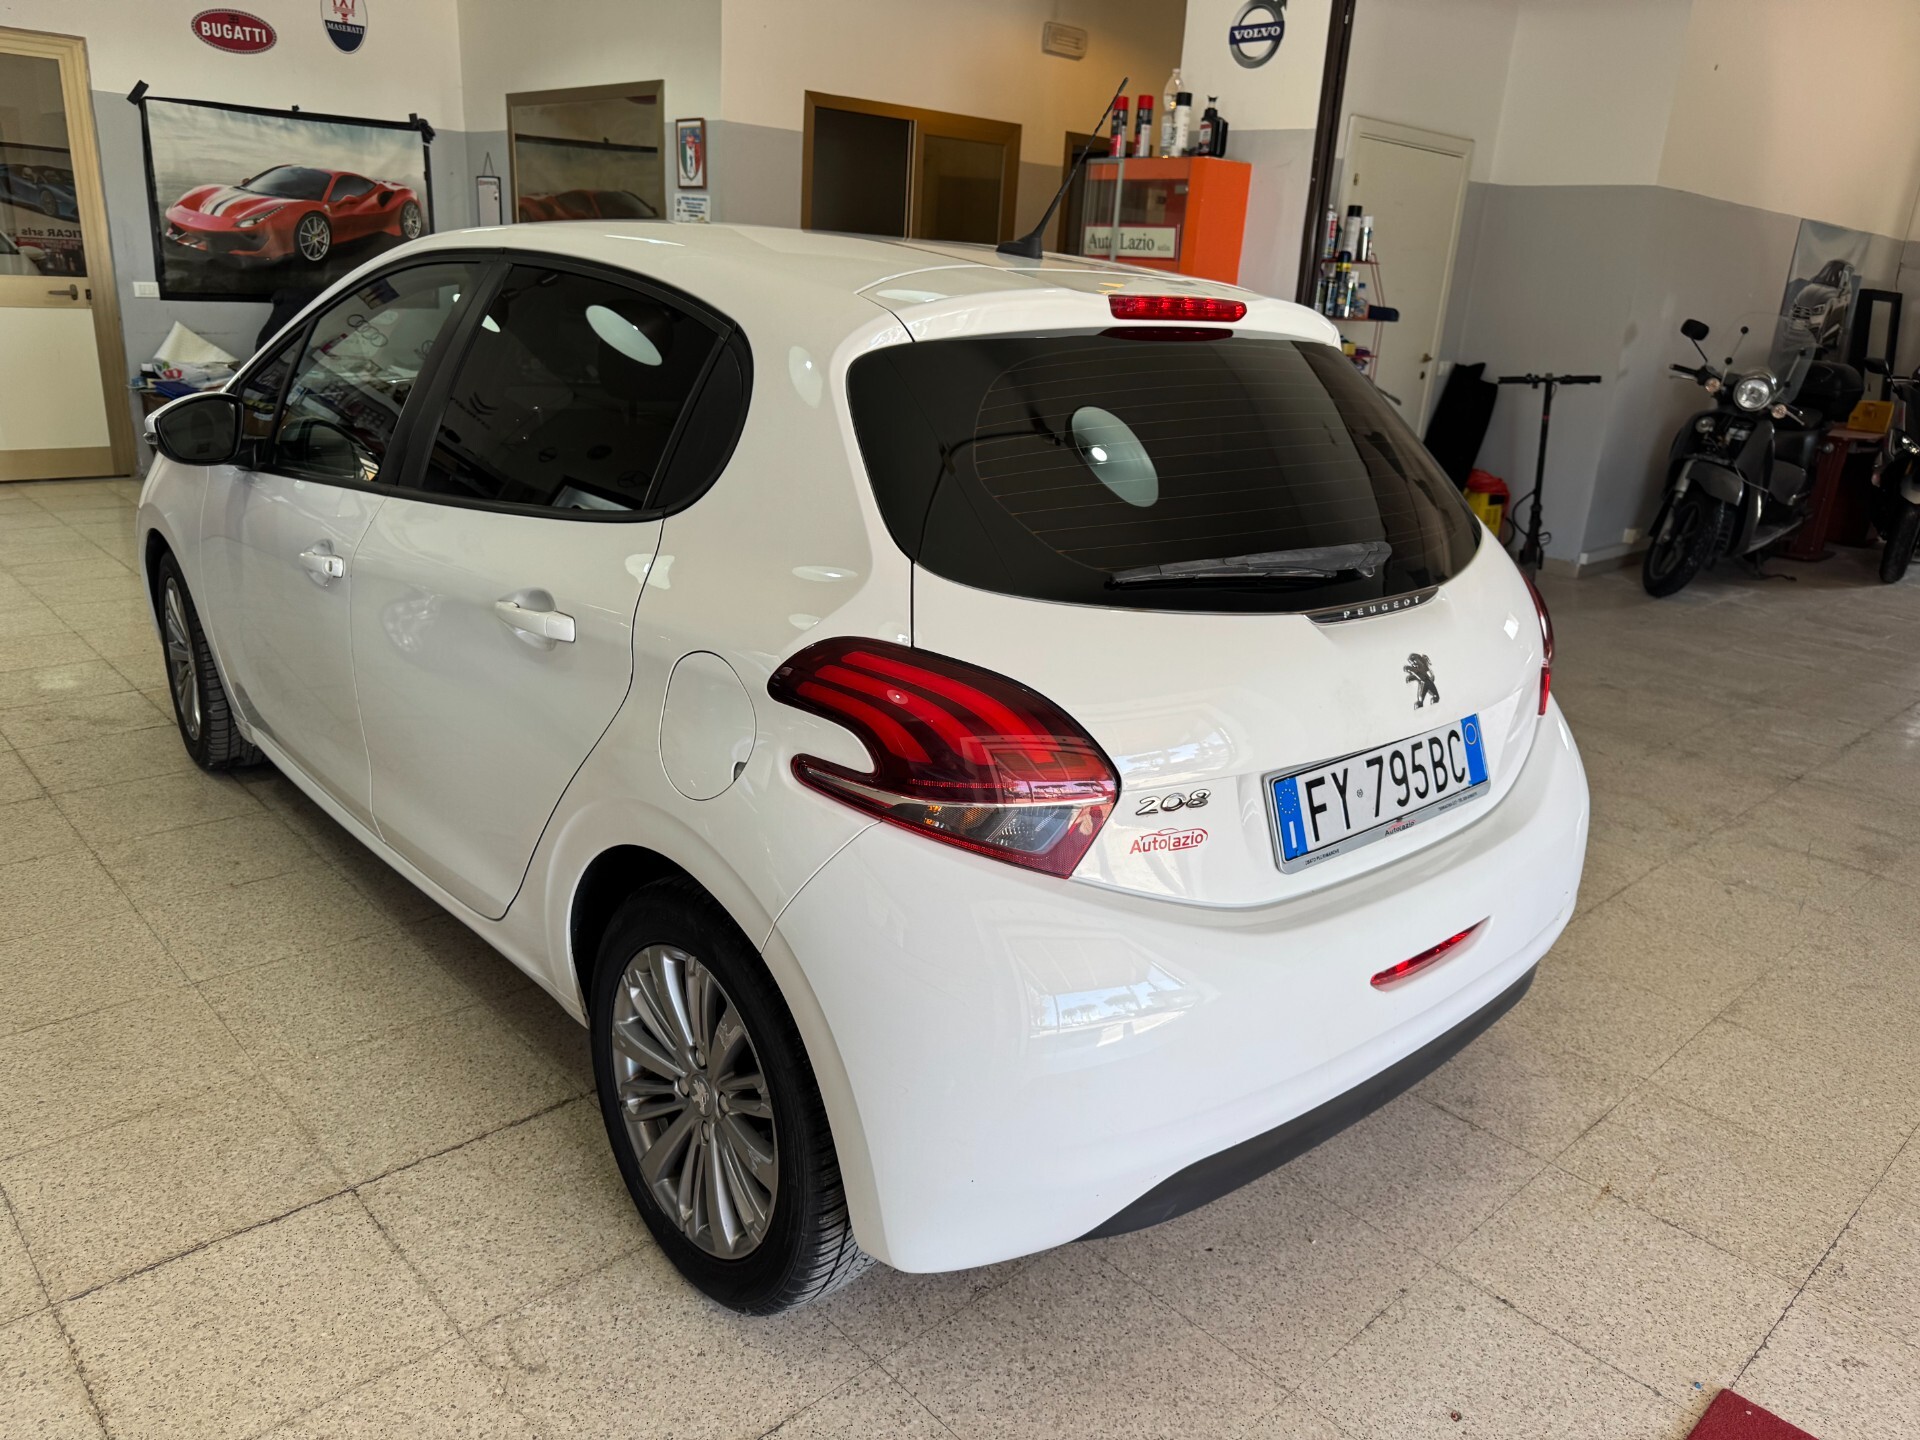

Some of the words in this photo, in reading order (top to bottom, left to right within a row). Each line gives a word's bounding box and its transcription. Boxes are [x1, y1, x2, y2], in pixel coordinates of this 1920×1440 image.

[200, 21, 267, 43] BUGATTI
[326, 22, 364, 35] MASERATI
[1233, 26, 1280, 40] VOLVO
[1119, 232, 1155, 251] Lazio
[1343, 596, 1420, 618] PEUGEOT
[1304, 767, 1351, 842] FY
[1365, 729, 1466, 818] 795BC
[1135, 788, 1211, 816] 208
